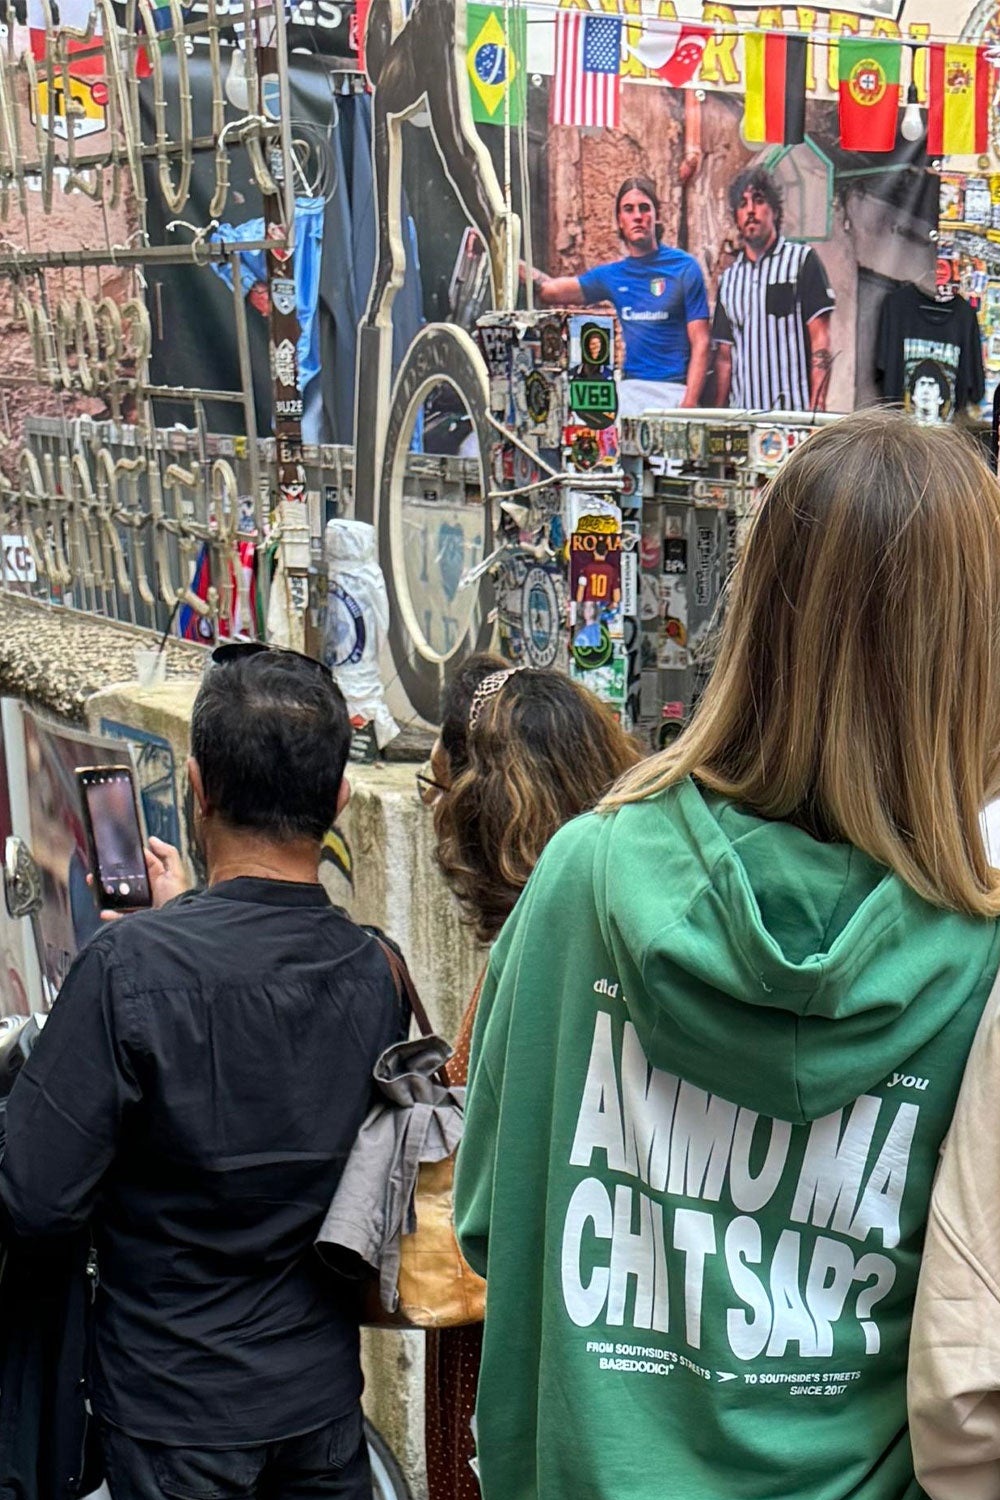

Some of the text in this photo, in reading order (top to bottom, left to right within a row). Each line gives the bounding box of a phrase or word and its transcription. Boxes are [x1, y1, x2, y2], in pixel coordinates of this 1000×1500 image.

[575, 383, 612, 406] V69
[590, 573, 607, 597] 10
[593, 978, 618, 998] did
[886, 1072, 929, 1092] you
[569, 1011, 920, 1248] AMMO MA
[586, 1341, 861, 1384] FROM SOUTHSIDE'S STREETS TO SOUTHSIDE'S STREETS
[790, 1385, 848, 1396] SINCE 2017
